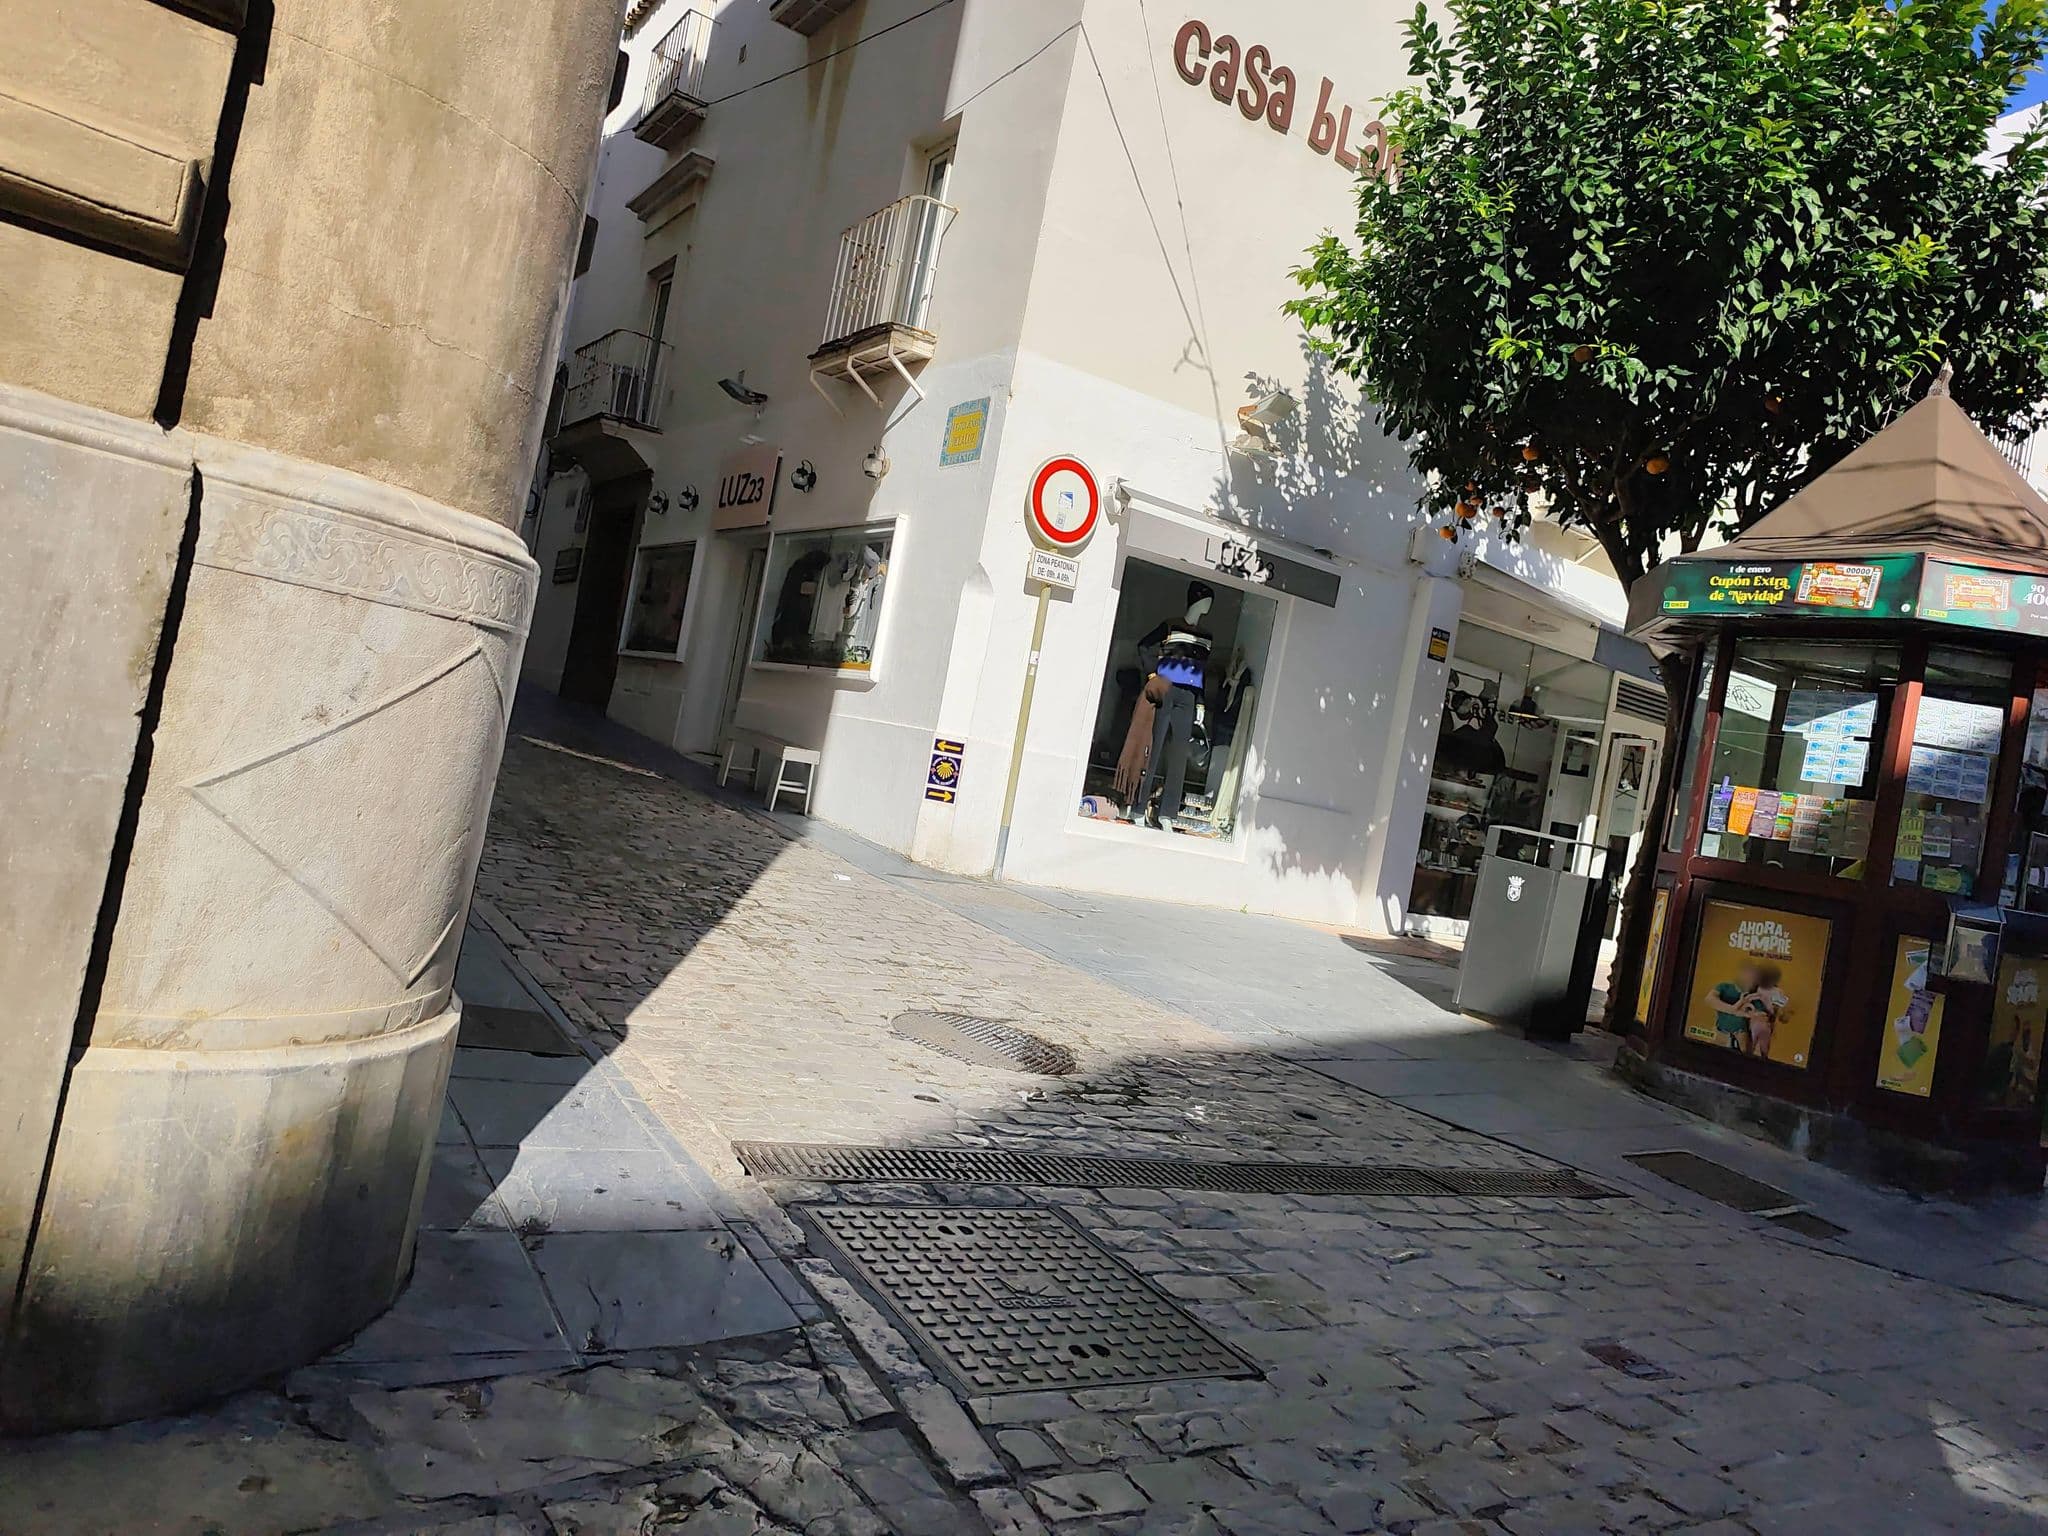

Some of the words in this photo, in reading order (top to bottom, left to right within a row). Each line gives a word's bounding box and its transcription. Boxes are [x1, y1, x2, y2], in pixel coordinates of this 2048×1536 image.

[719, 472, 765, 508] LUZ23
[1036, 554, 1051, 566] ZONA
[1050, 558, 1076, 573] PEATONAL
[1735, 565, 1746, 573] de
[1747, 566, 1772, 574] enero
[1709, 574, 1751, 588] Cupón
[1753, 575, 1791, 590] Extra
[1709, 589, 1725, 601] de
[1728, 588, 1785, 605] Navidad
[1738, 920, 1783, 938] AHORA
[1728, 931, 1792, 954] SIEMPRE
